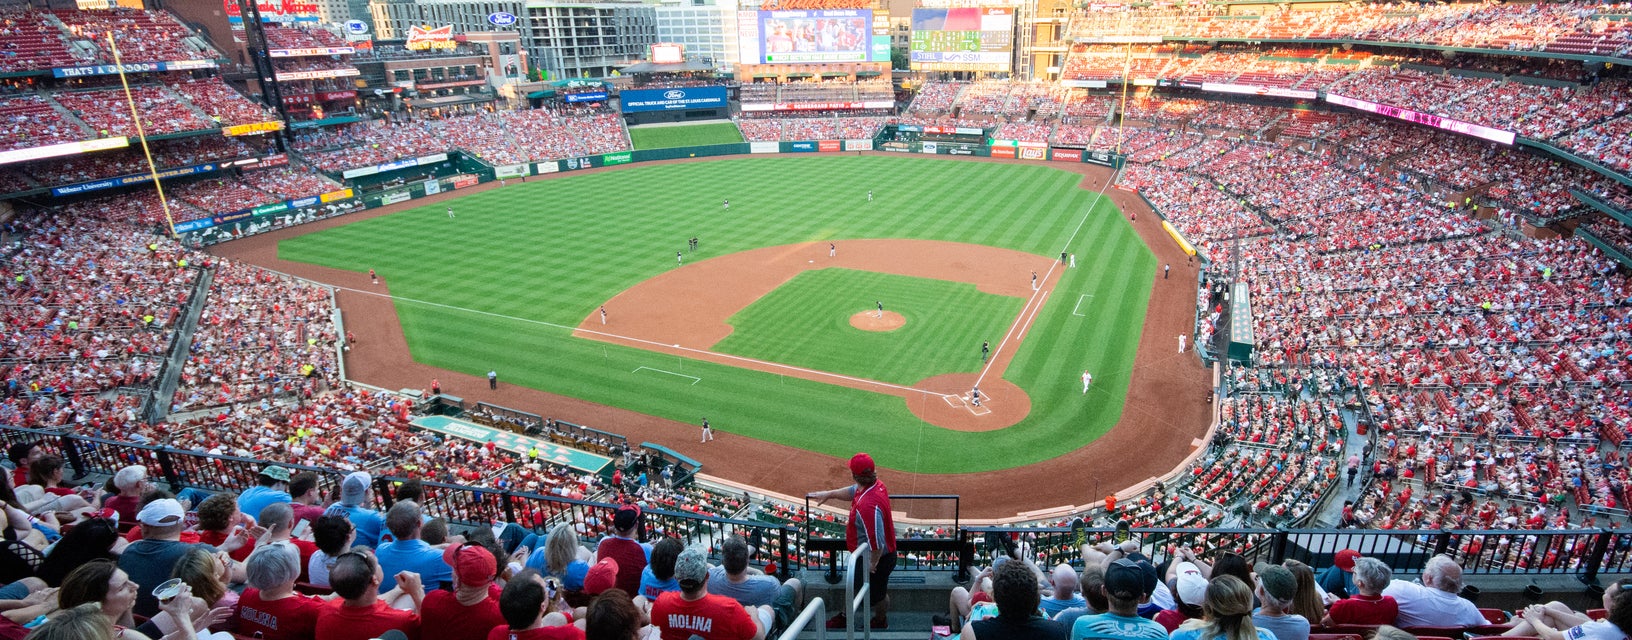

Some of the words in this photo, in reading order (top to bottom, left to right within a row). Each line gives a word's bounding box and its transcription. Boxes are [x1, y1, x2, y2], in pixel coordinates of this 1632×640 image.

[494, 14, 512, 24] Ford
[409, 29, 451, 41] Budweiser
[406, 41, 431, 51] BREW
[430, 40, 457, 50] HOUSE
[963, 53, 981, 61] SSM
[62, 65, 93, 77] THAT'S
[97, 65, 105, 74] A
[667, 90, 682, 98] Ford
[793, 102, 829, 110] SCOREBOARD
[230, 124, 252, 135] BIG
[252, 121, 280, 132] MAC
[1054, 151, 1079, 159] EQUIFAX
[57, 185, 82, 195] Webster
[82, 180, 114, 191] University
[240, 604, 278, 631] MOLINA
[667, 613, 713, 633] MOLINA
